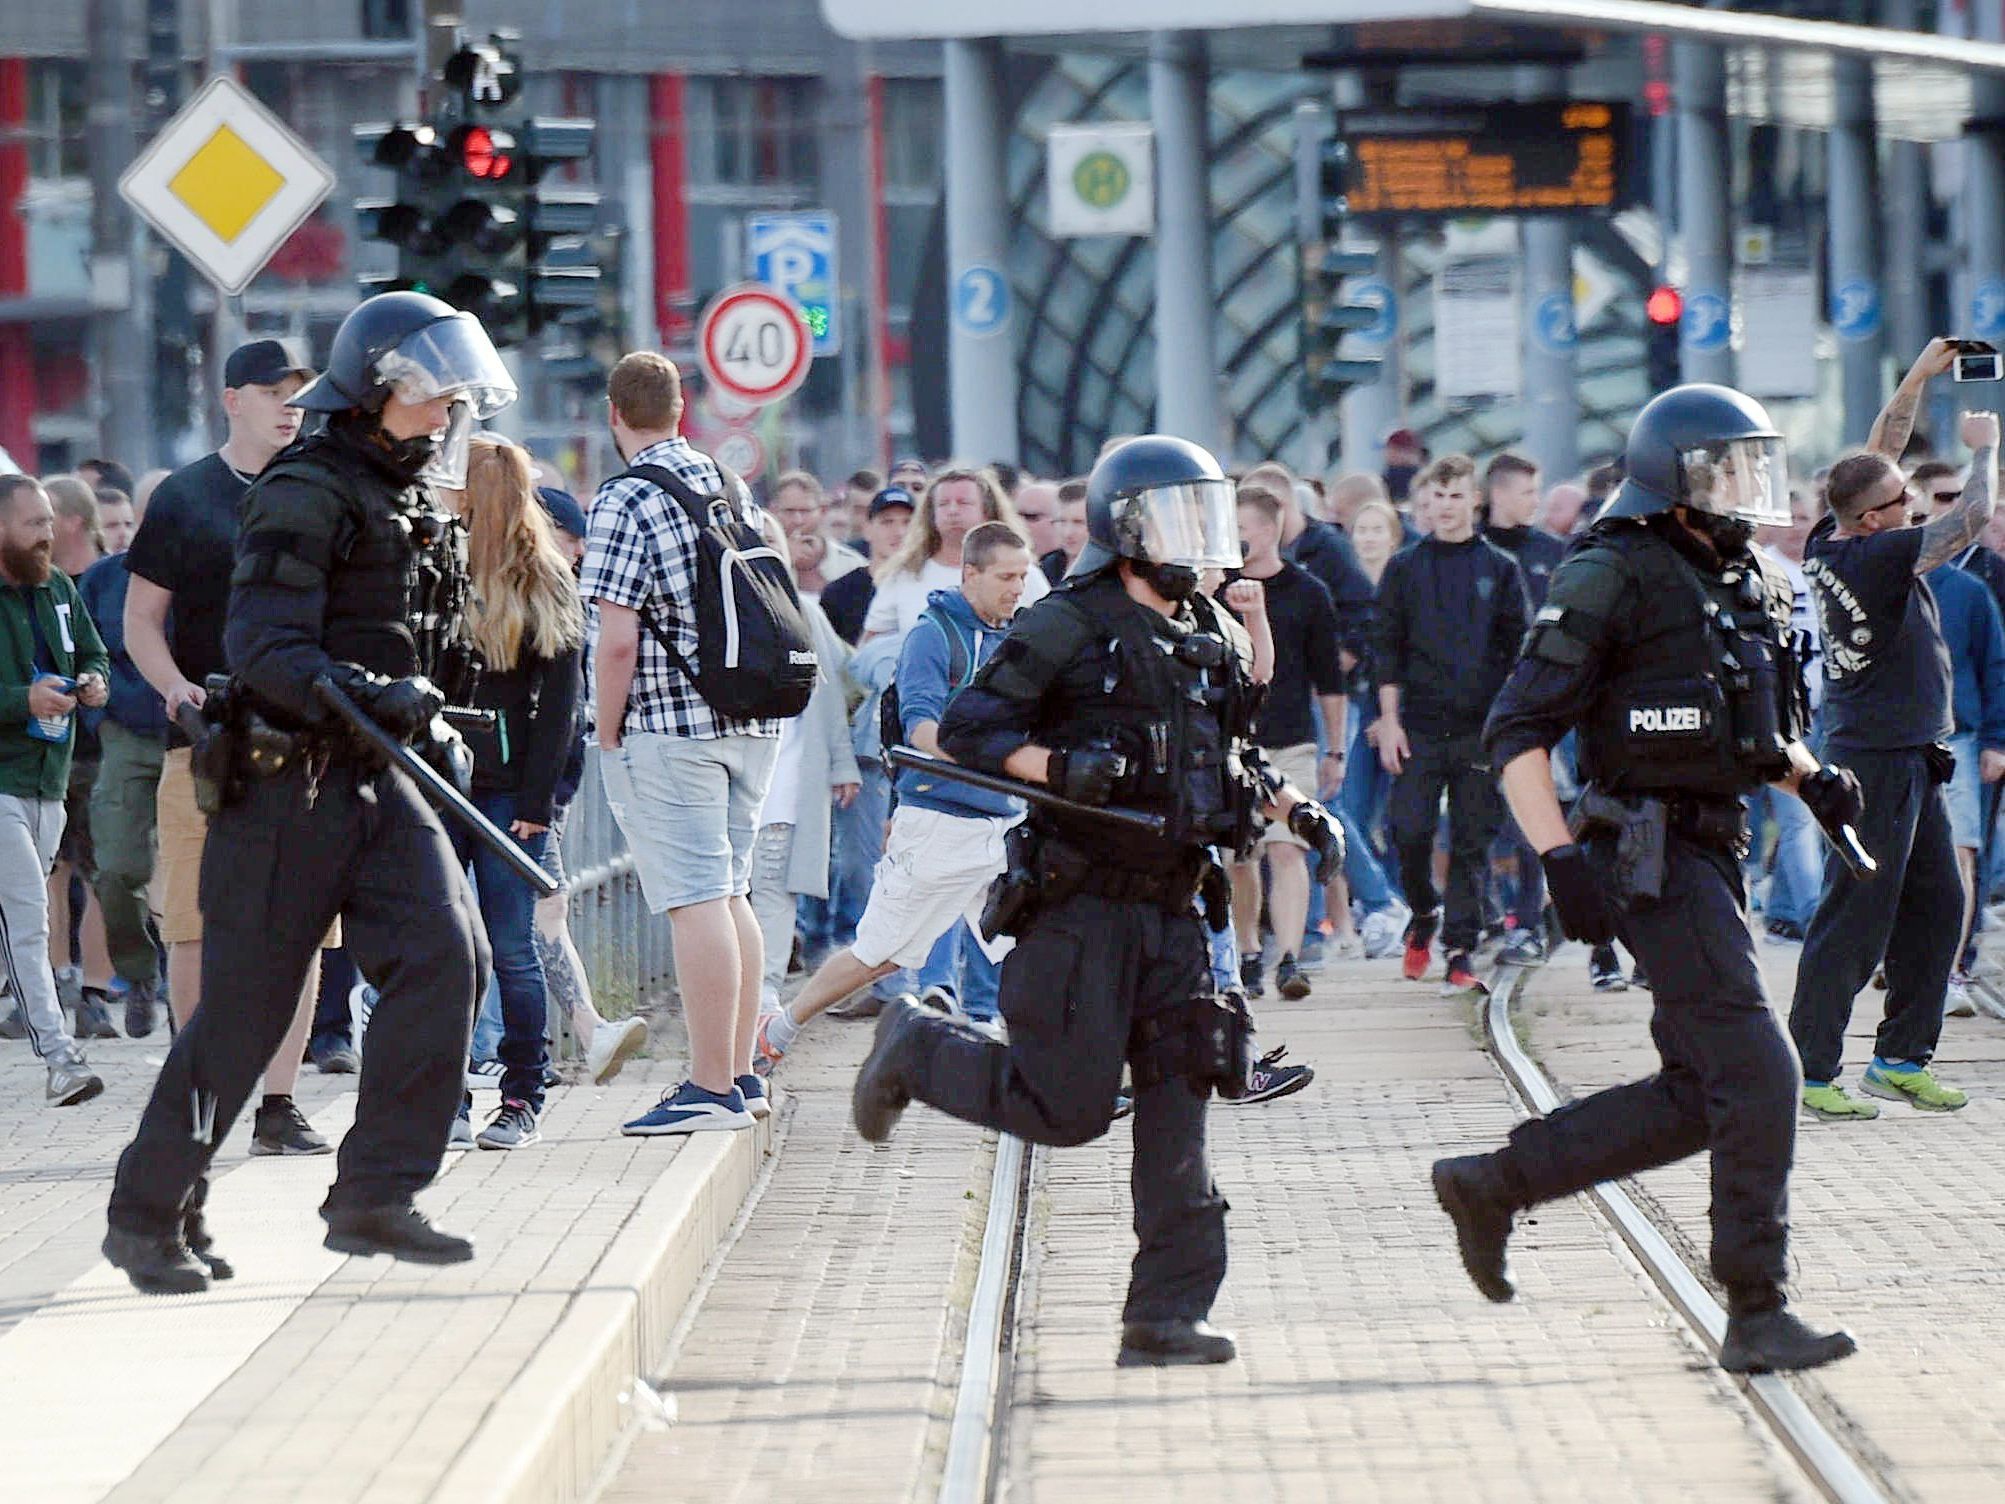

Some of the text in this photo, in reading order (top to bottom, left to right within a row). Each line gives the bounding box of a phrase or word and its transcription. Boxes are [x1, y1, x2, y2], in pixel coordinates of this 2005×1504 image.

[772, 250, 813, 299] P
[968, 276, 994, 322] 2
[725, 321, 784, 367] 40
[1629, 707, 1701, 732] POLIZEI
